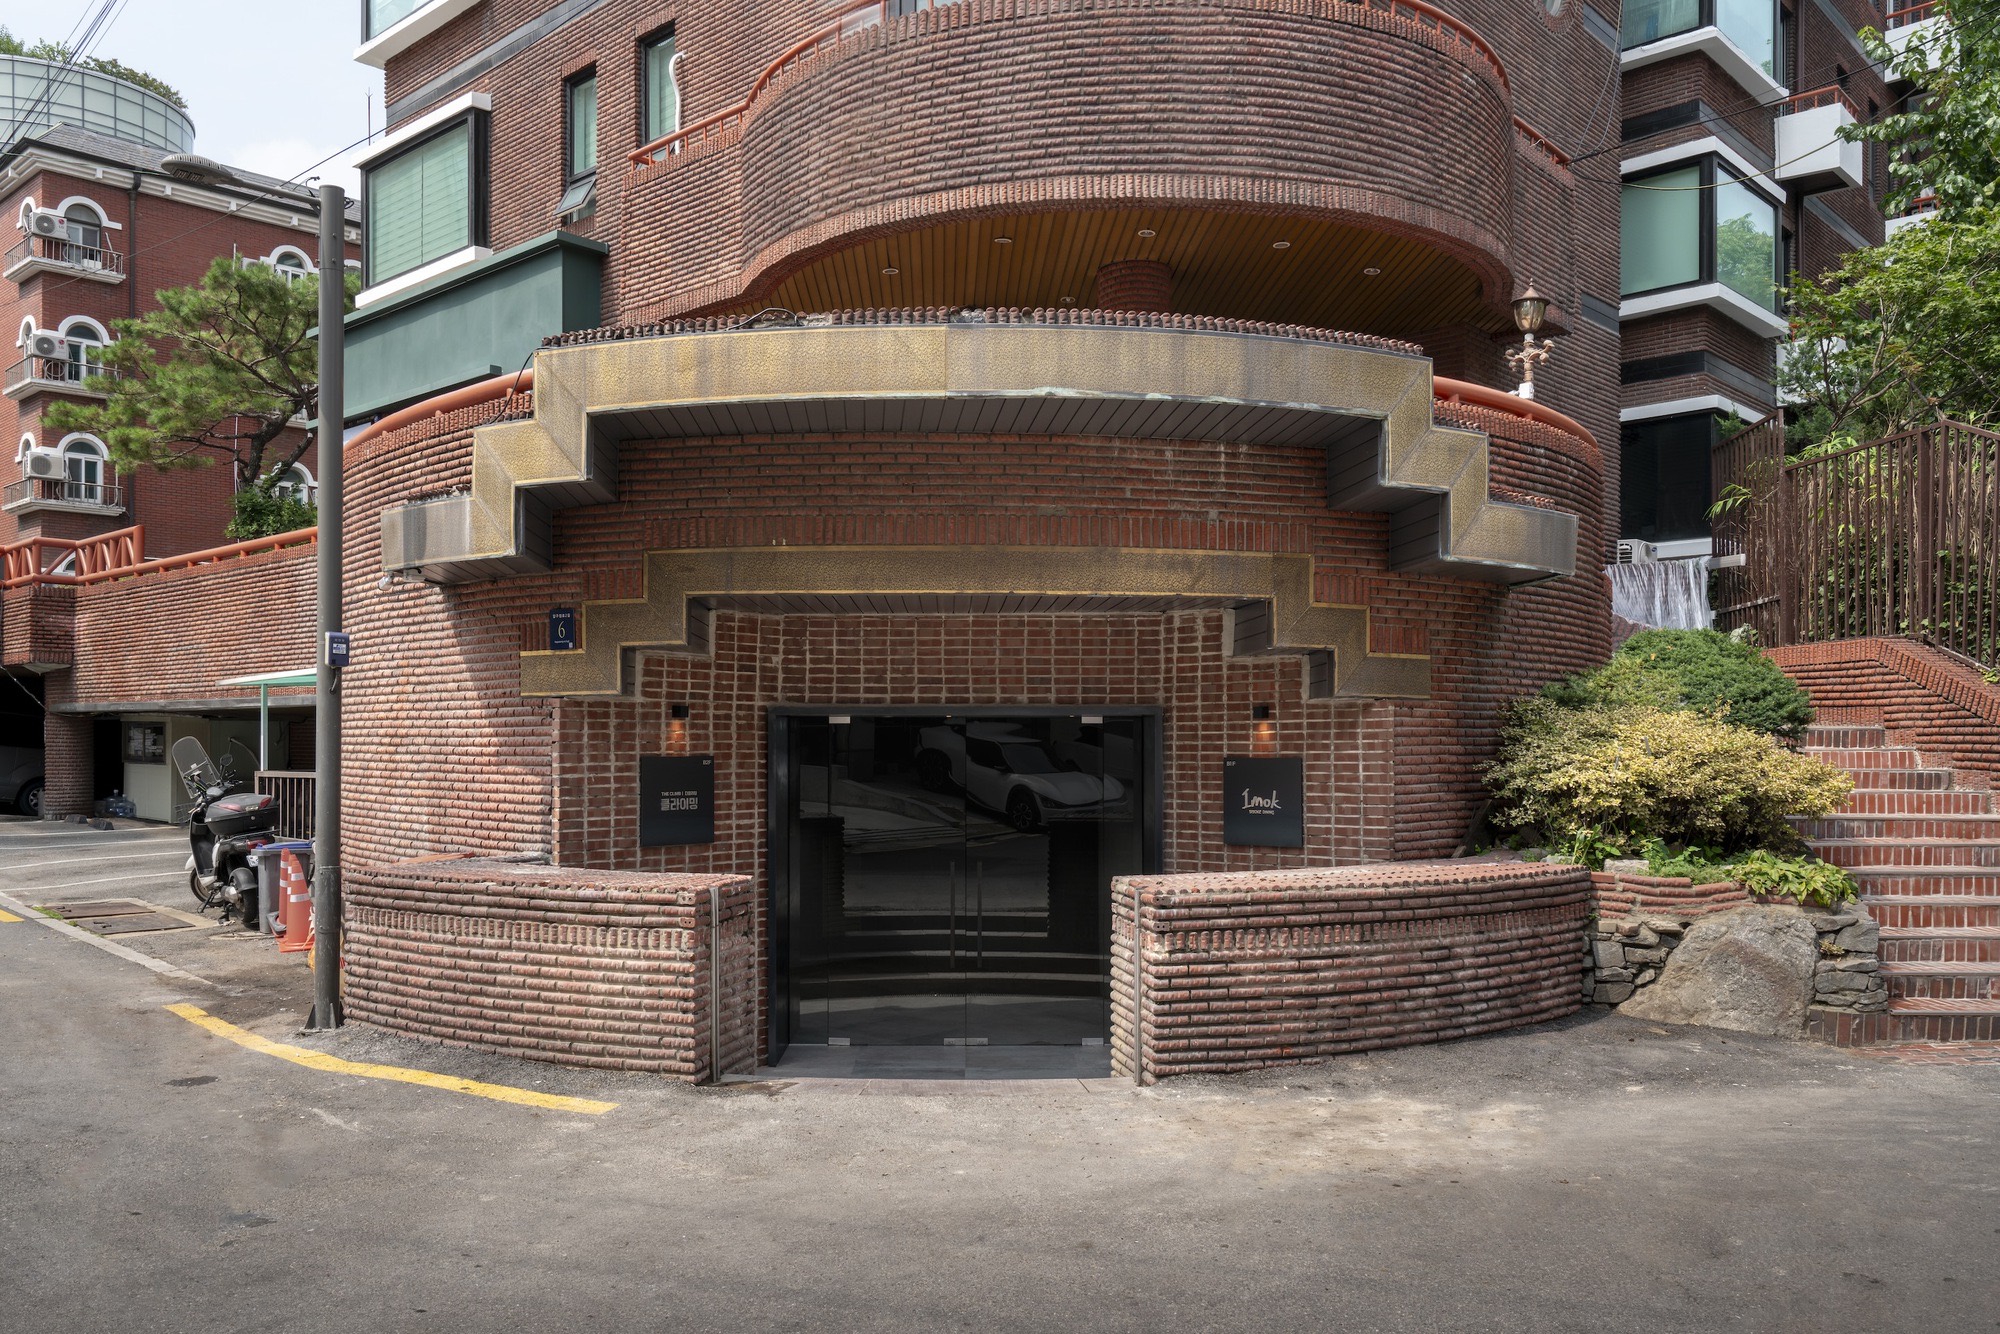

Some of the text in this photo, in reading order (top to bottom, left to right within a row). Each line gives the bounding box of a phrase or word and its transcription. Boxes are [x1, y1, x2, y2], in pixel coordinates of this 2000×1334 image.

[558, 621, 565, 638] 6
[661, 797, 698, 811] 클라이밍
[1241, 788, 1282, 809] Imok
